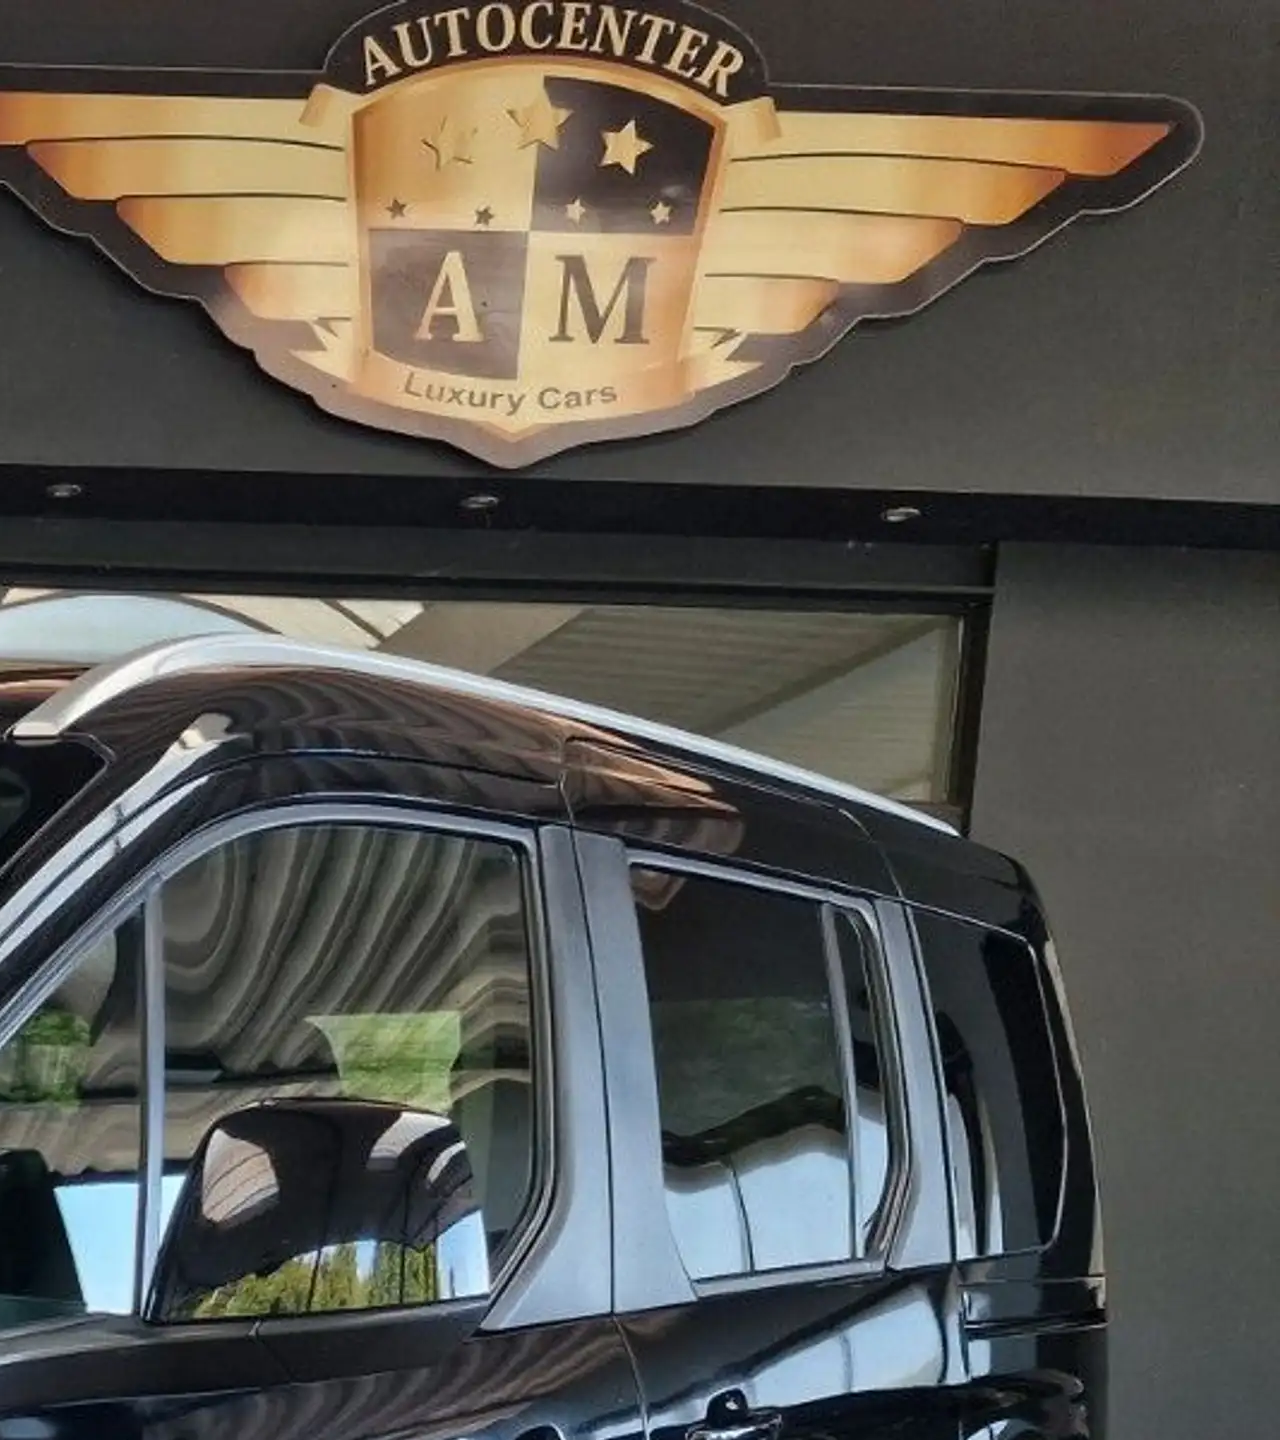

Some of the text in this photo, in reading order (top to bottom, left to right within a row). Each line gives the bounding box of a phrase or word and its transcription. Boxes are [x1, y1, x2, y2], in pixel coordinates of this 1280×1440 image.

[362, 1, 744, 98] AUTOCENTER
[413, 250, 657, 345] A M
[403, 371, 618, 417] Luxury Cars
